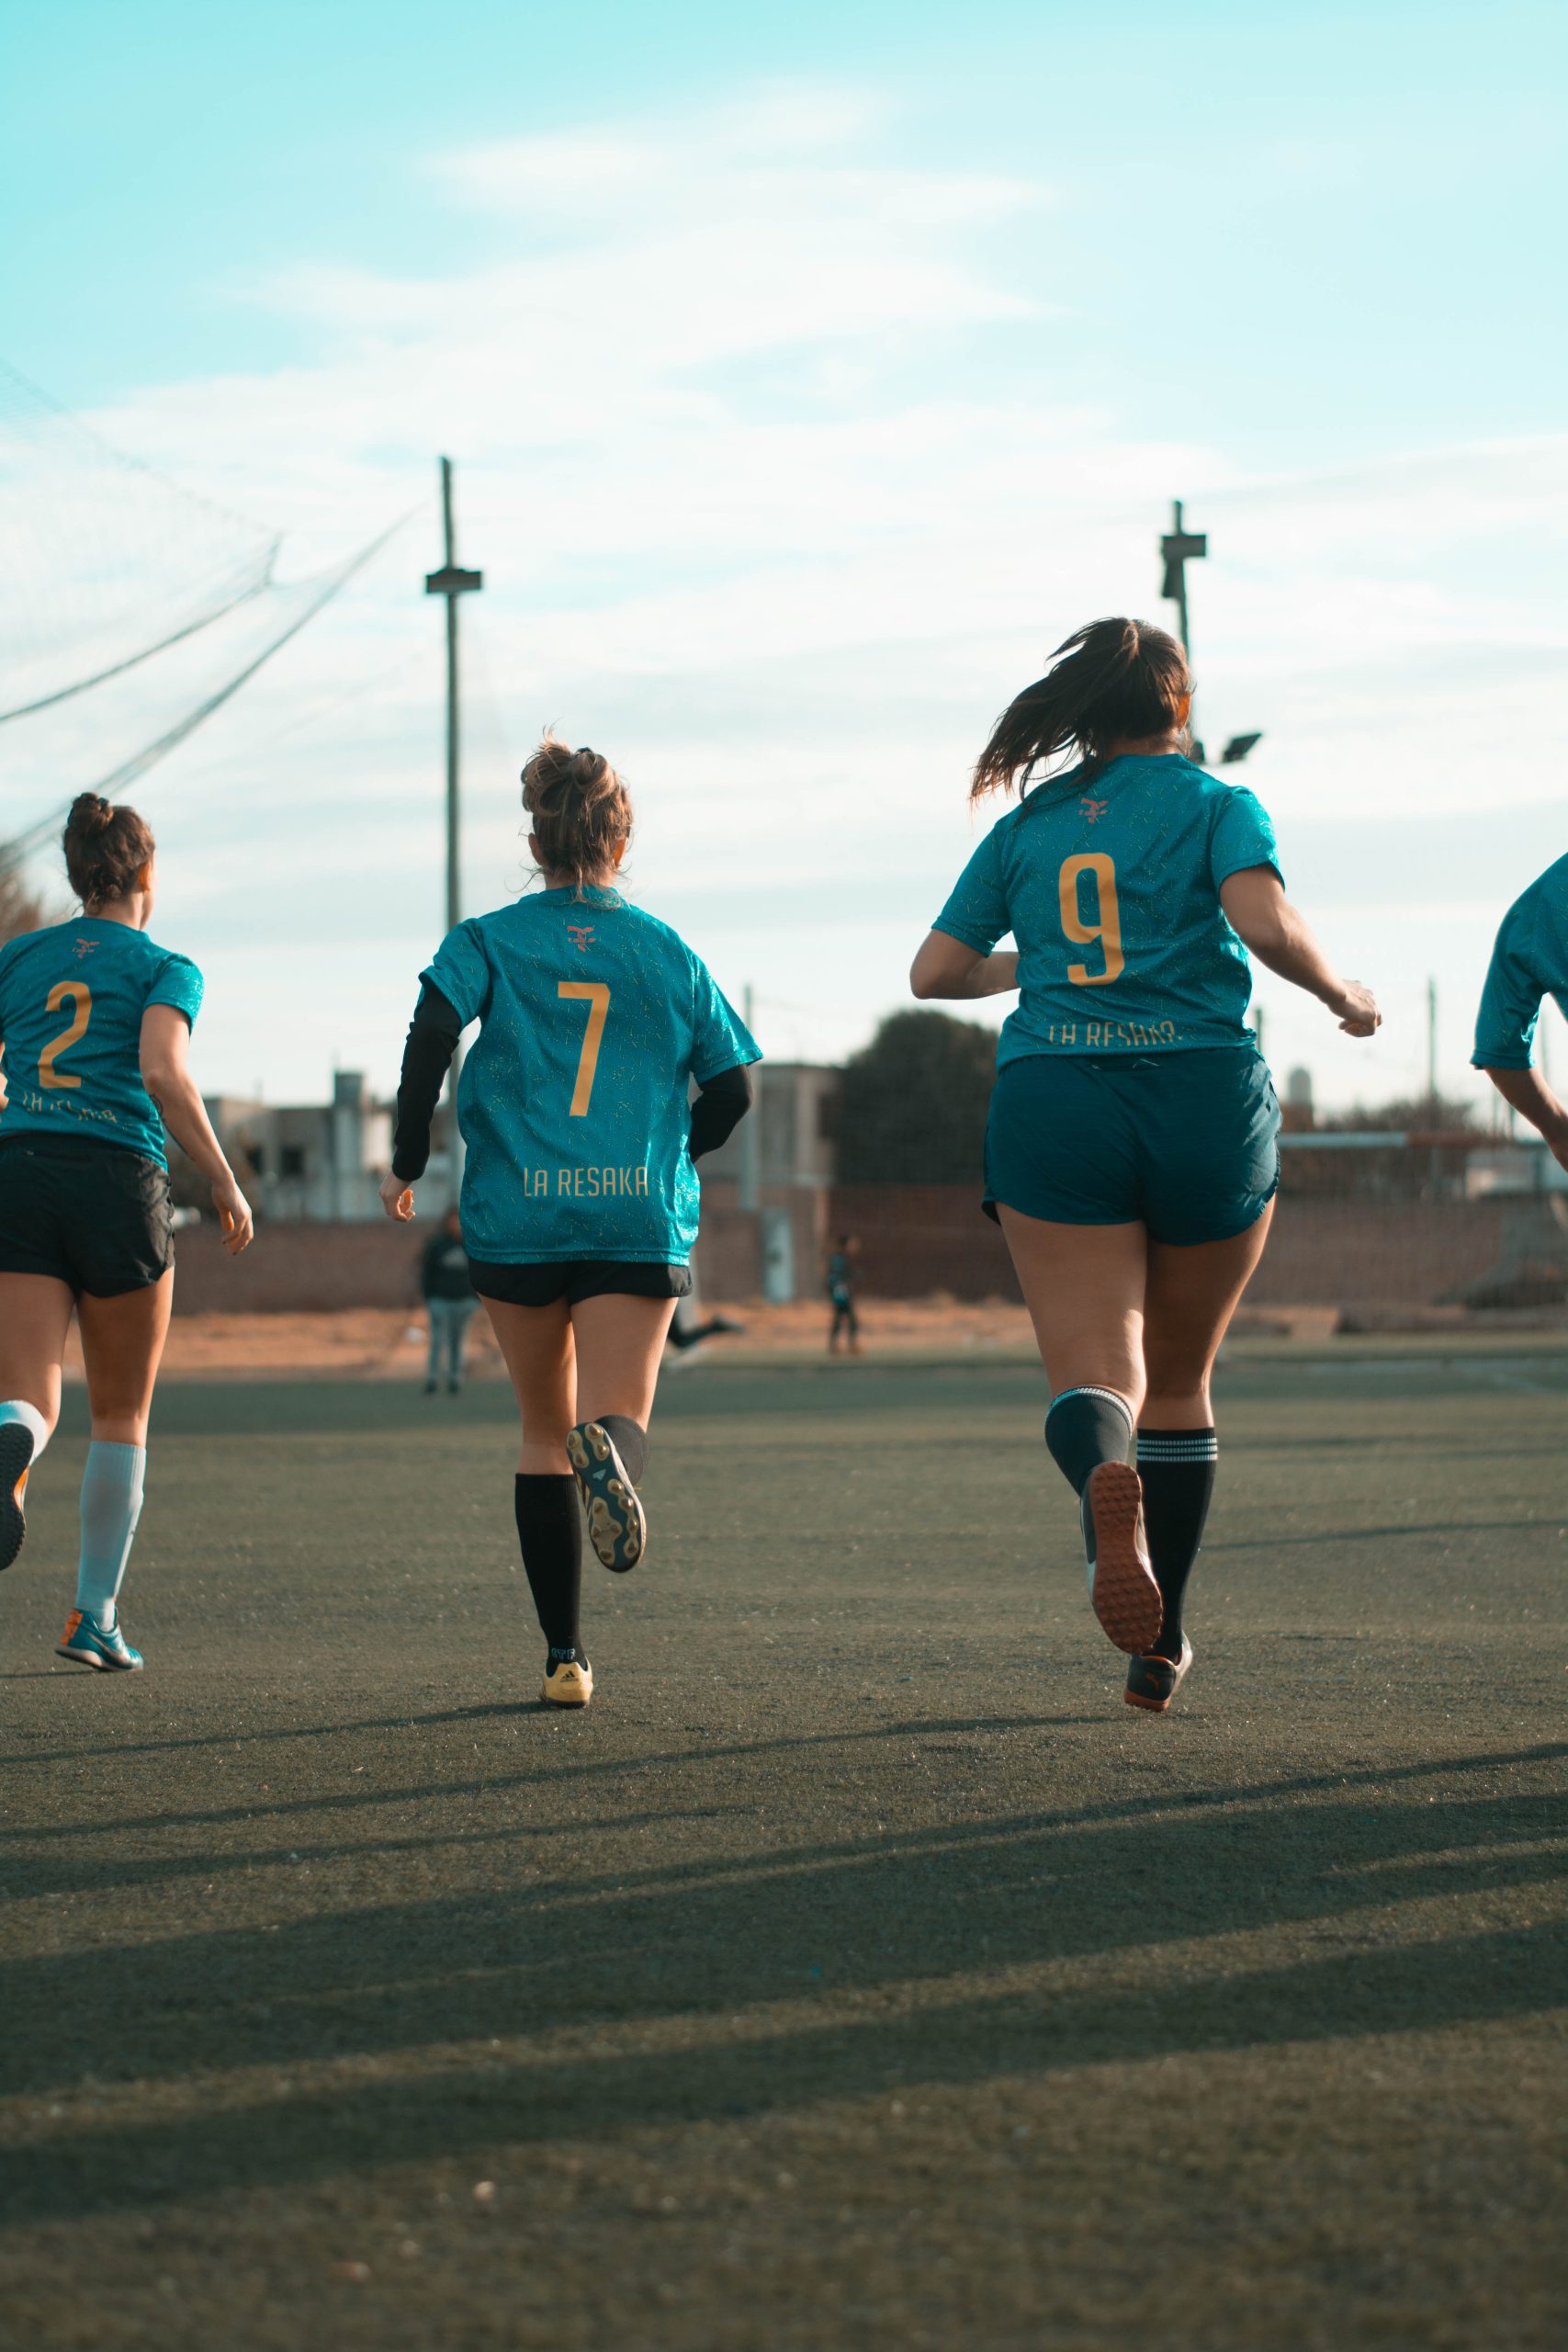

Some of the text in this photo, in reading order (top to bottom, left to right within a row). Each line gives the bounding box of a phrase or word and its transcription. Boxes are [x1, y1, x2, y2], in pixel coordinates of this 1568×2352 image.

[1059, 853, 1125, 986] 9
[38, 980, 92, 1089] 2
[558, 981, 611, 1116] 7
[524, 1167, 649, 1197] LA RESAKA
